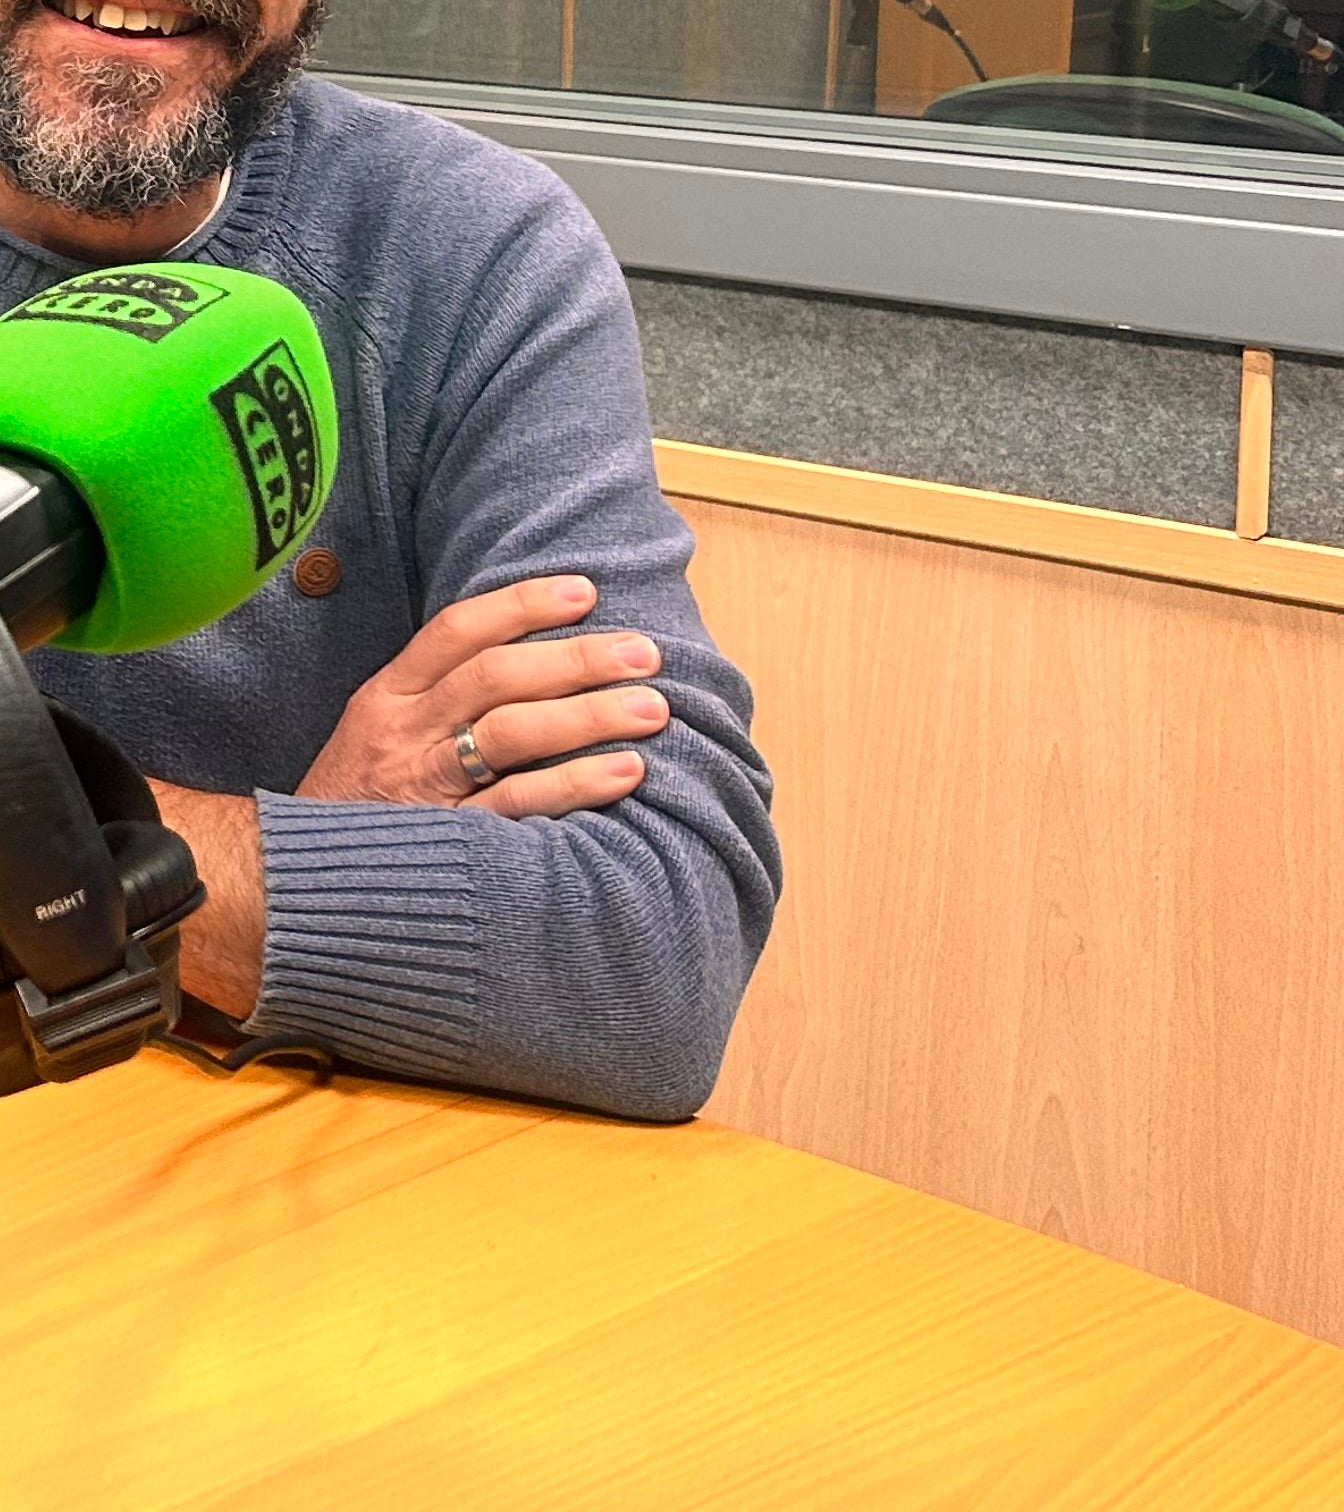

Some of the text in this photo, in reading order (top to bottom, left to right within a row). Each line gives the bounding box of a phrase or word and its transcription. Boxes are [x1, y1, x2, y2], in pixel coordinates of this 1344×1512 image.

[45, 295, 156, 320] CERO
[246, 410, 287, 529] CERO
[35, 888, 87, 920] RIGHT
